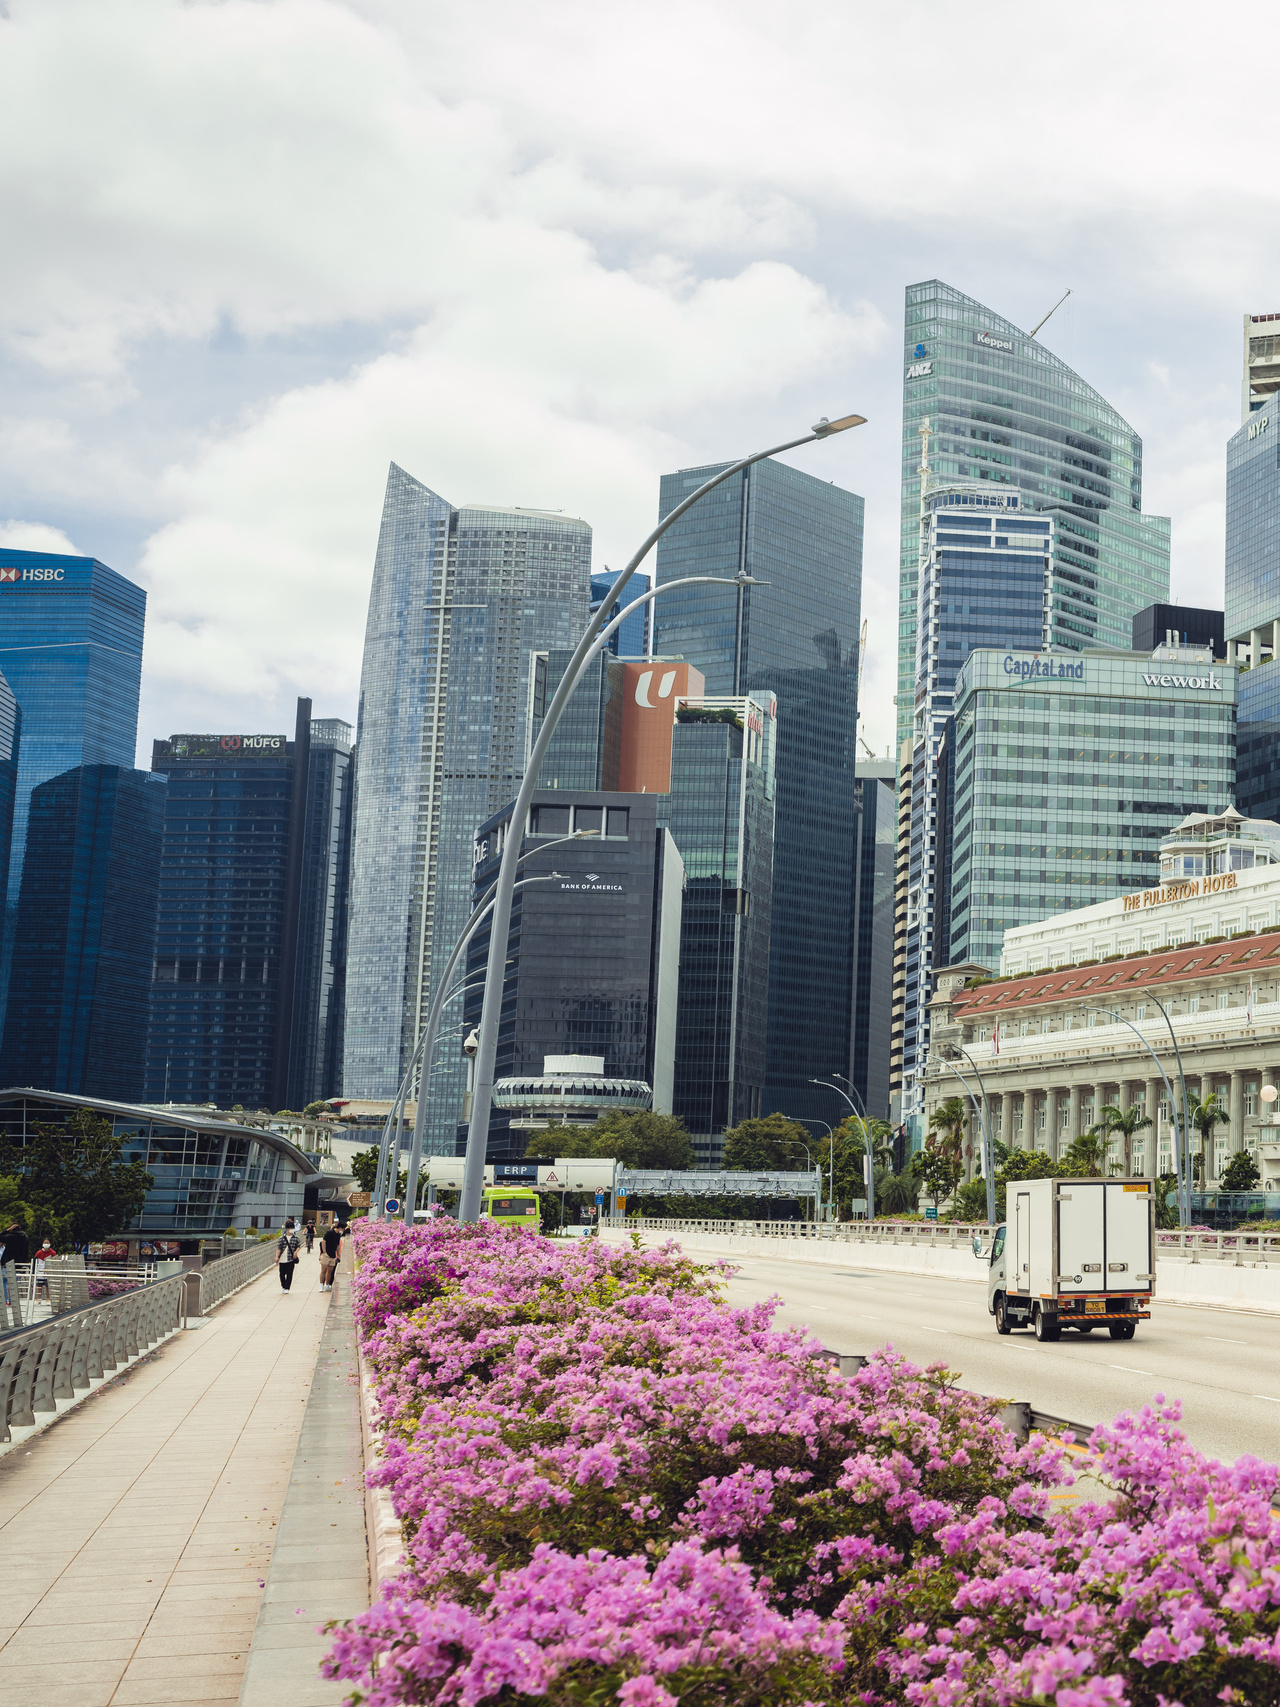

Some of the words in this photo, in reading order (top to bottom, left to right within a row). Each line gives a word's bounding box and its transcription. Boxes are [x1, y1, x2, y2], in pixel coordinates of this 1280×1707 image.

[977, 332, 1012, 350] Keppel
[906, 362, 933, 379] ANZ
[1248, 417, 1269, 440] MYP
[22, 568, 65, 581] HSBC
[1003, 654, 1084, 680] CapitaLand
[1142, 671, 1223, 690] wework
[243, 737, 280, 748] MUFG
[1122, 894, 1140, 911] THE
[1143, 880, 1199, 907] FULLERTON
[1203, 872, 1238, 894] HOTEL
[504, 1166, 527, 1175] ERP
